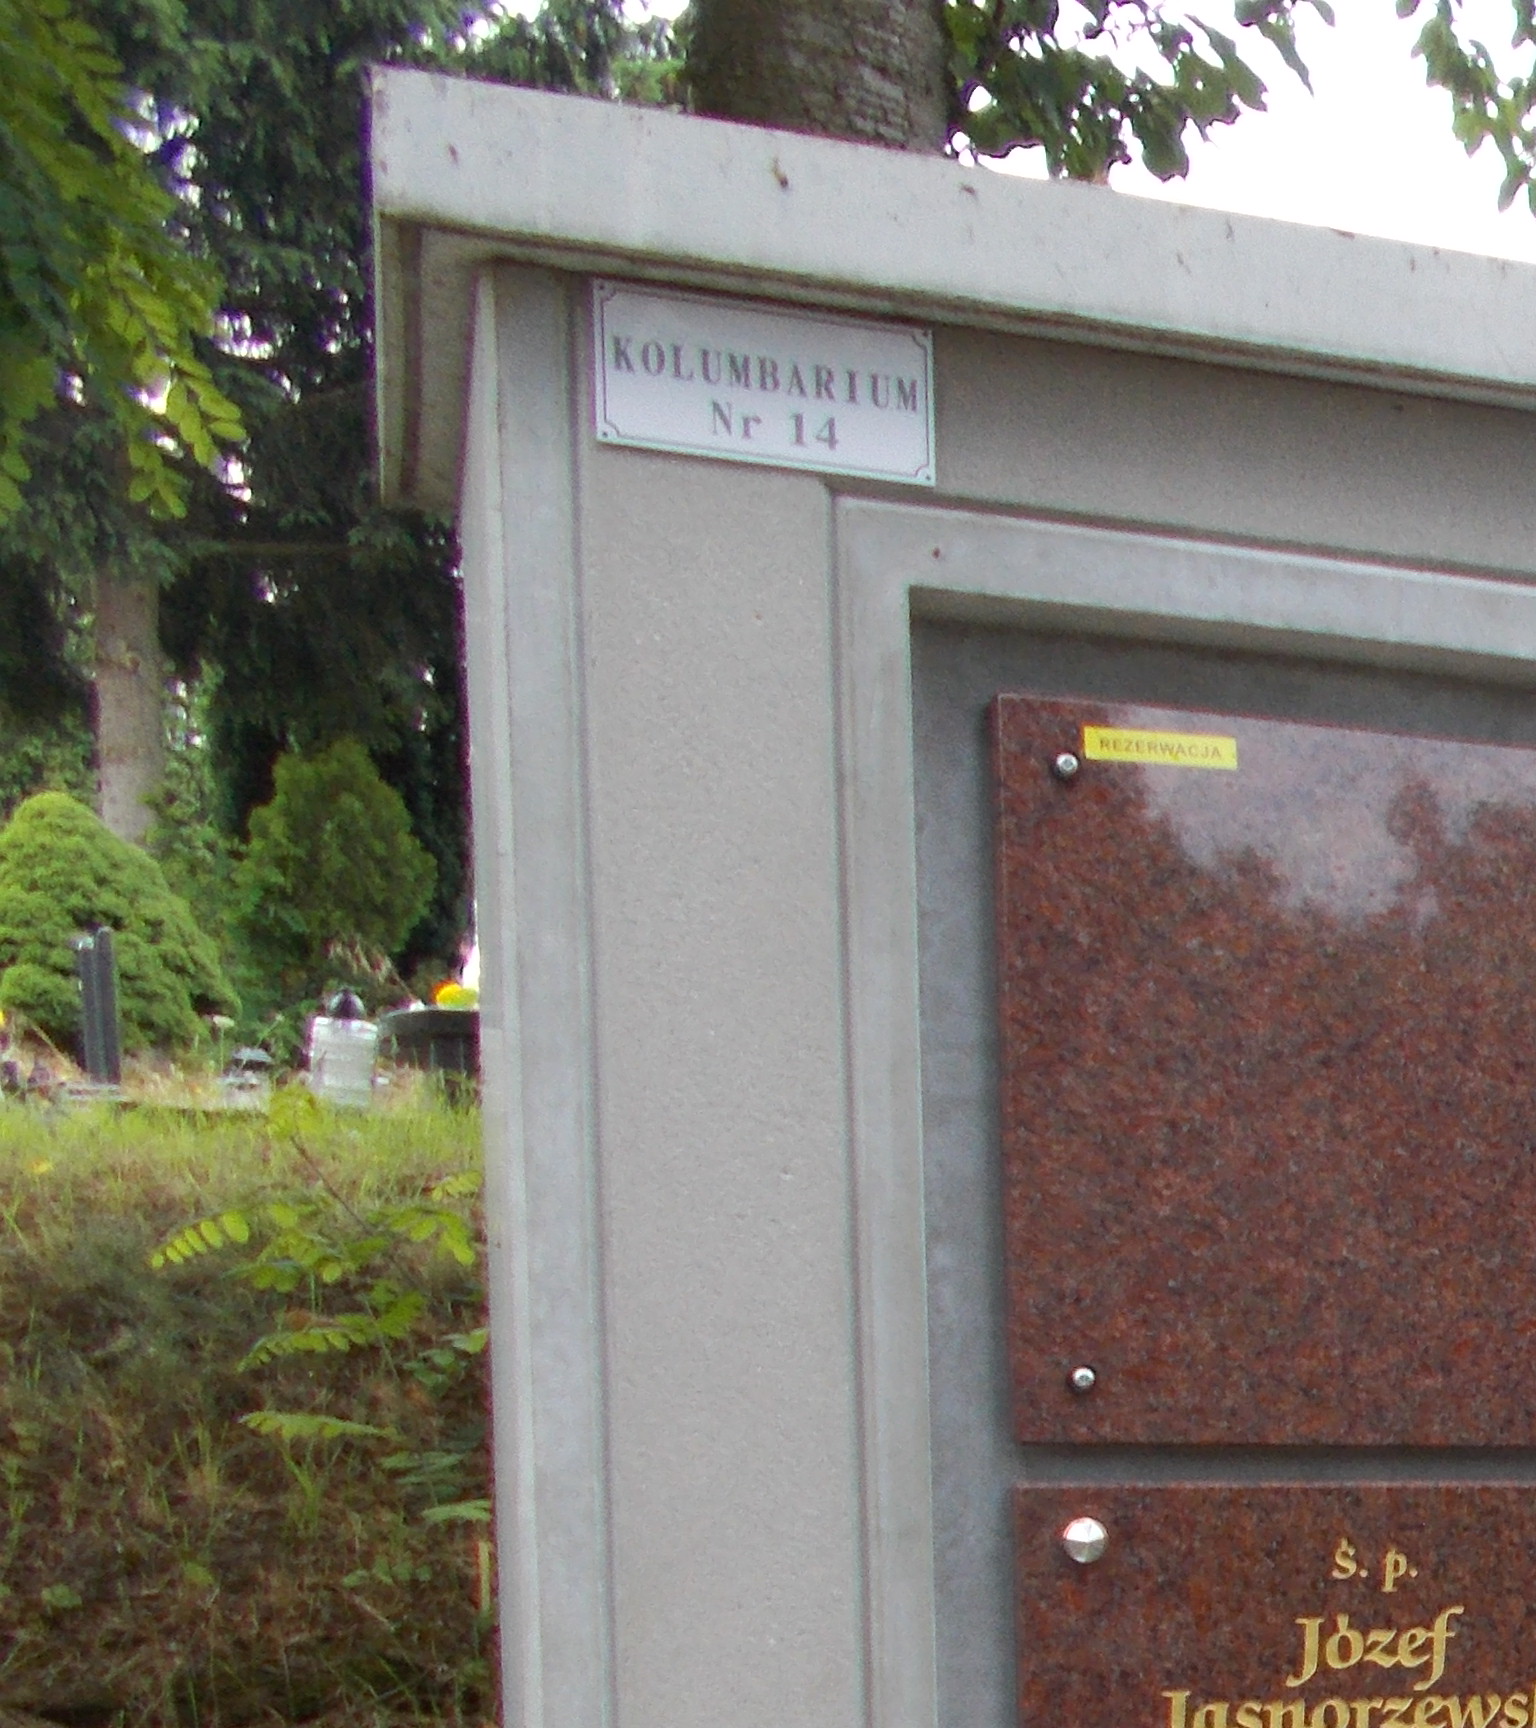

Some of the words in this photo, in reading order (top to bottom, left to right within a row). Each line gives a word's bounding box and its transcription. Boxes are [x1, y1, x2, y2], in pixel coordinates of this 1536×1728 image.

[611, 335, 920, 415] KOLUMBARIUM
[710, 401, 762, 440] Nr
[789, 411, 839, 451] 14
[1100, 737, 1222, 759] REZERWACJA
[1286, 1606, 1463, 1692] Józef
